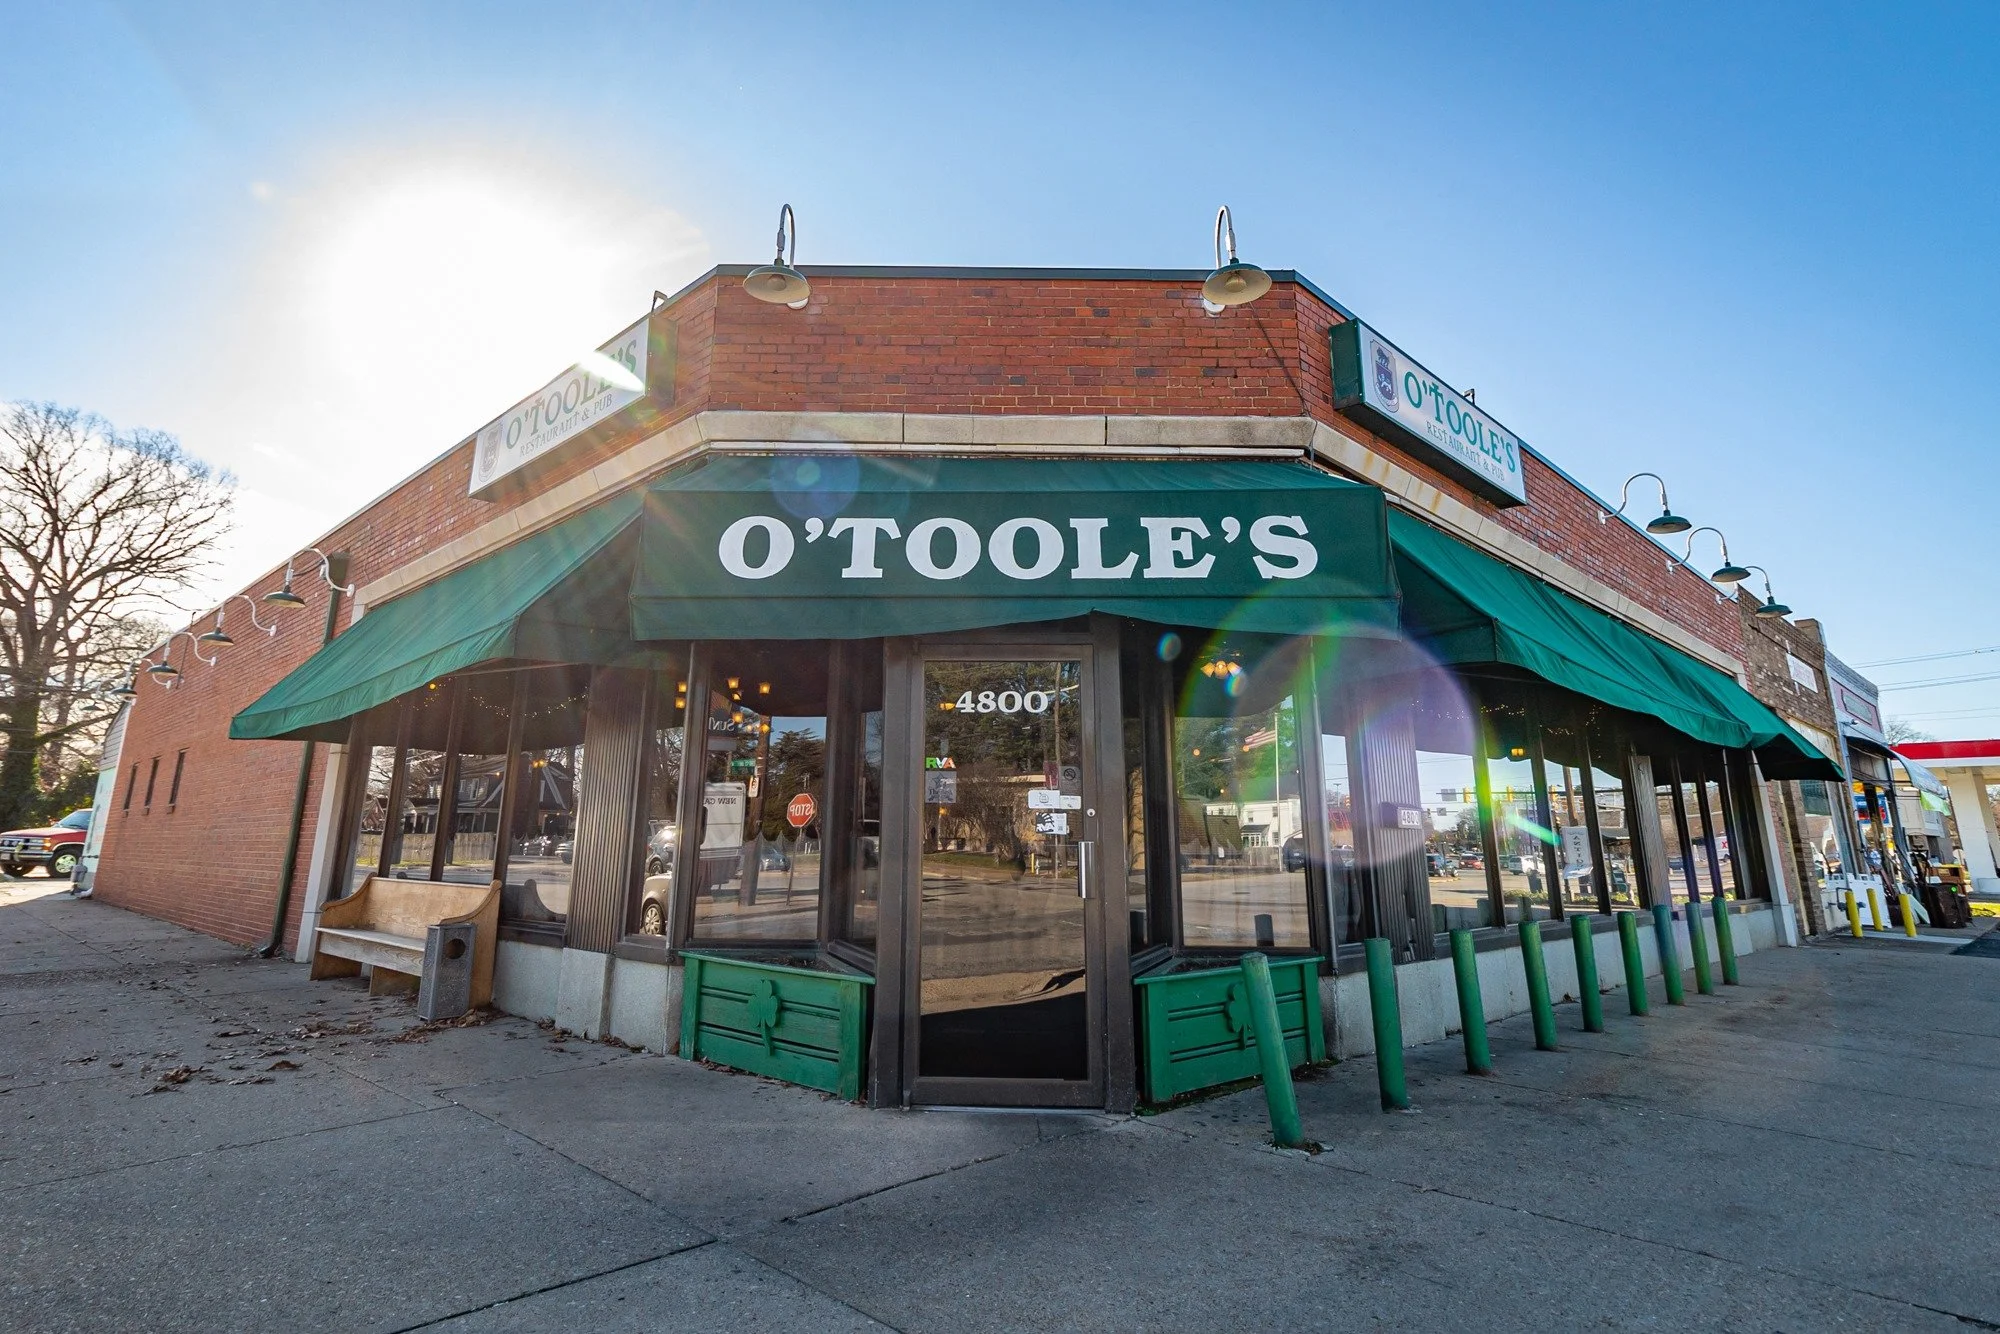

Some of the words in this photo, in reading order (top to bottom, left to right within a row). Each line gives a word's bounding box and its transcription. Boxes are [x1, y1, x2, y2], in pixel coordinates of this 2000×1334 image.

[520, 411, 581, 456] RESTAURANT
[581, 407, 590, 421] &
[594, 393, 613, 415] PUB
[1404, 371, 1516, 473] O'TOOLE'S
[1427, 421, 1481, 465] RESTAURANT
[1491, 463, 1505, 482] PUB
[718, 515, 1319, 580] O'TOOLE'S
[955, 690, 1049, 713] 4800
[925, 757, 957, 769] RVA
